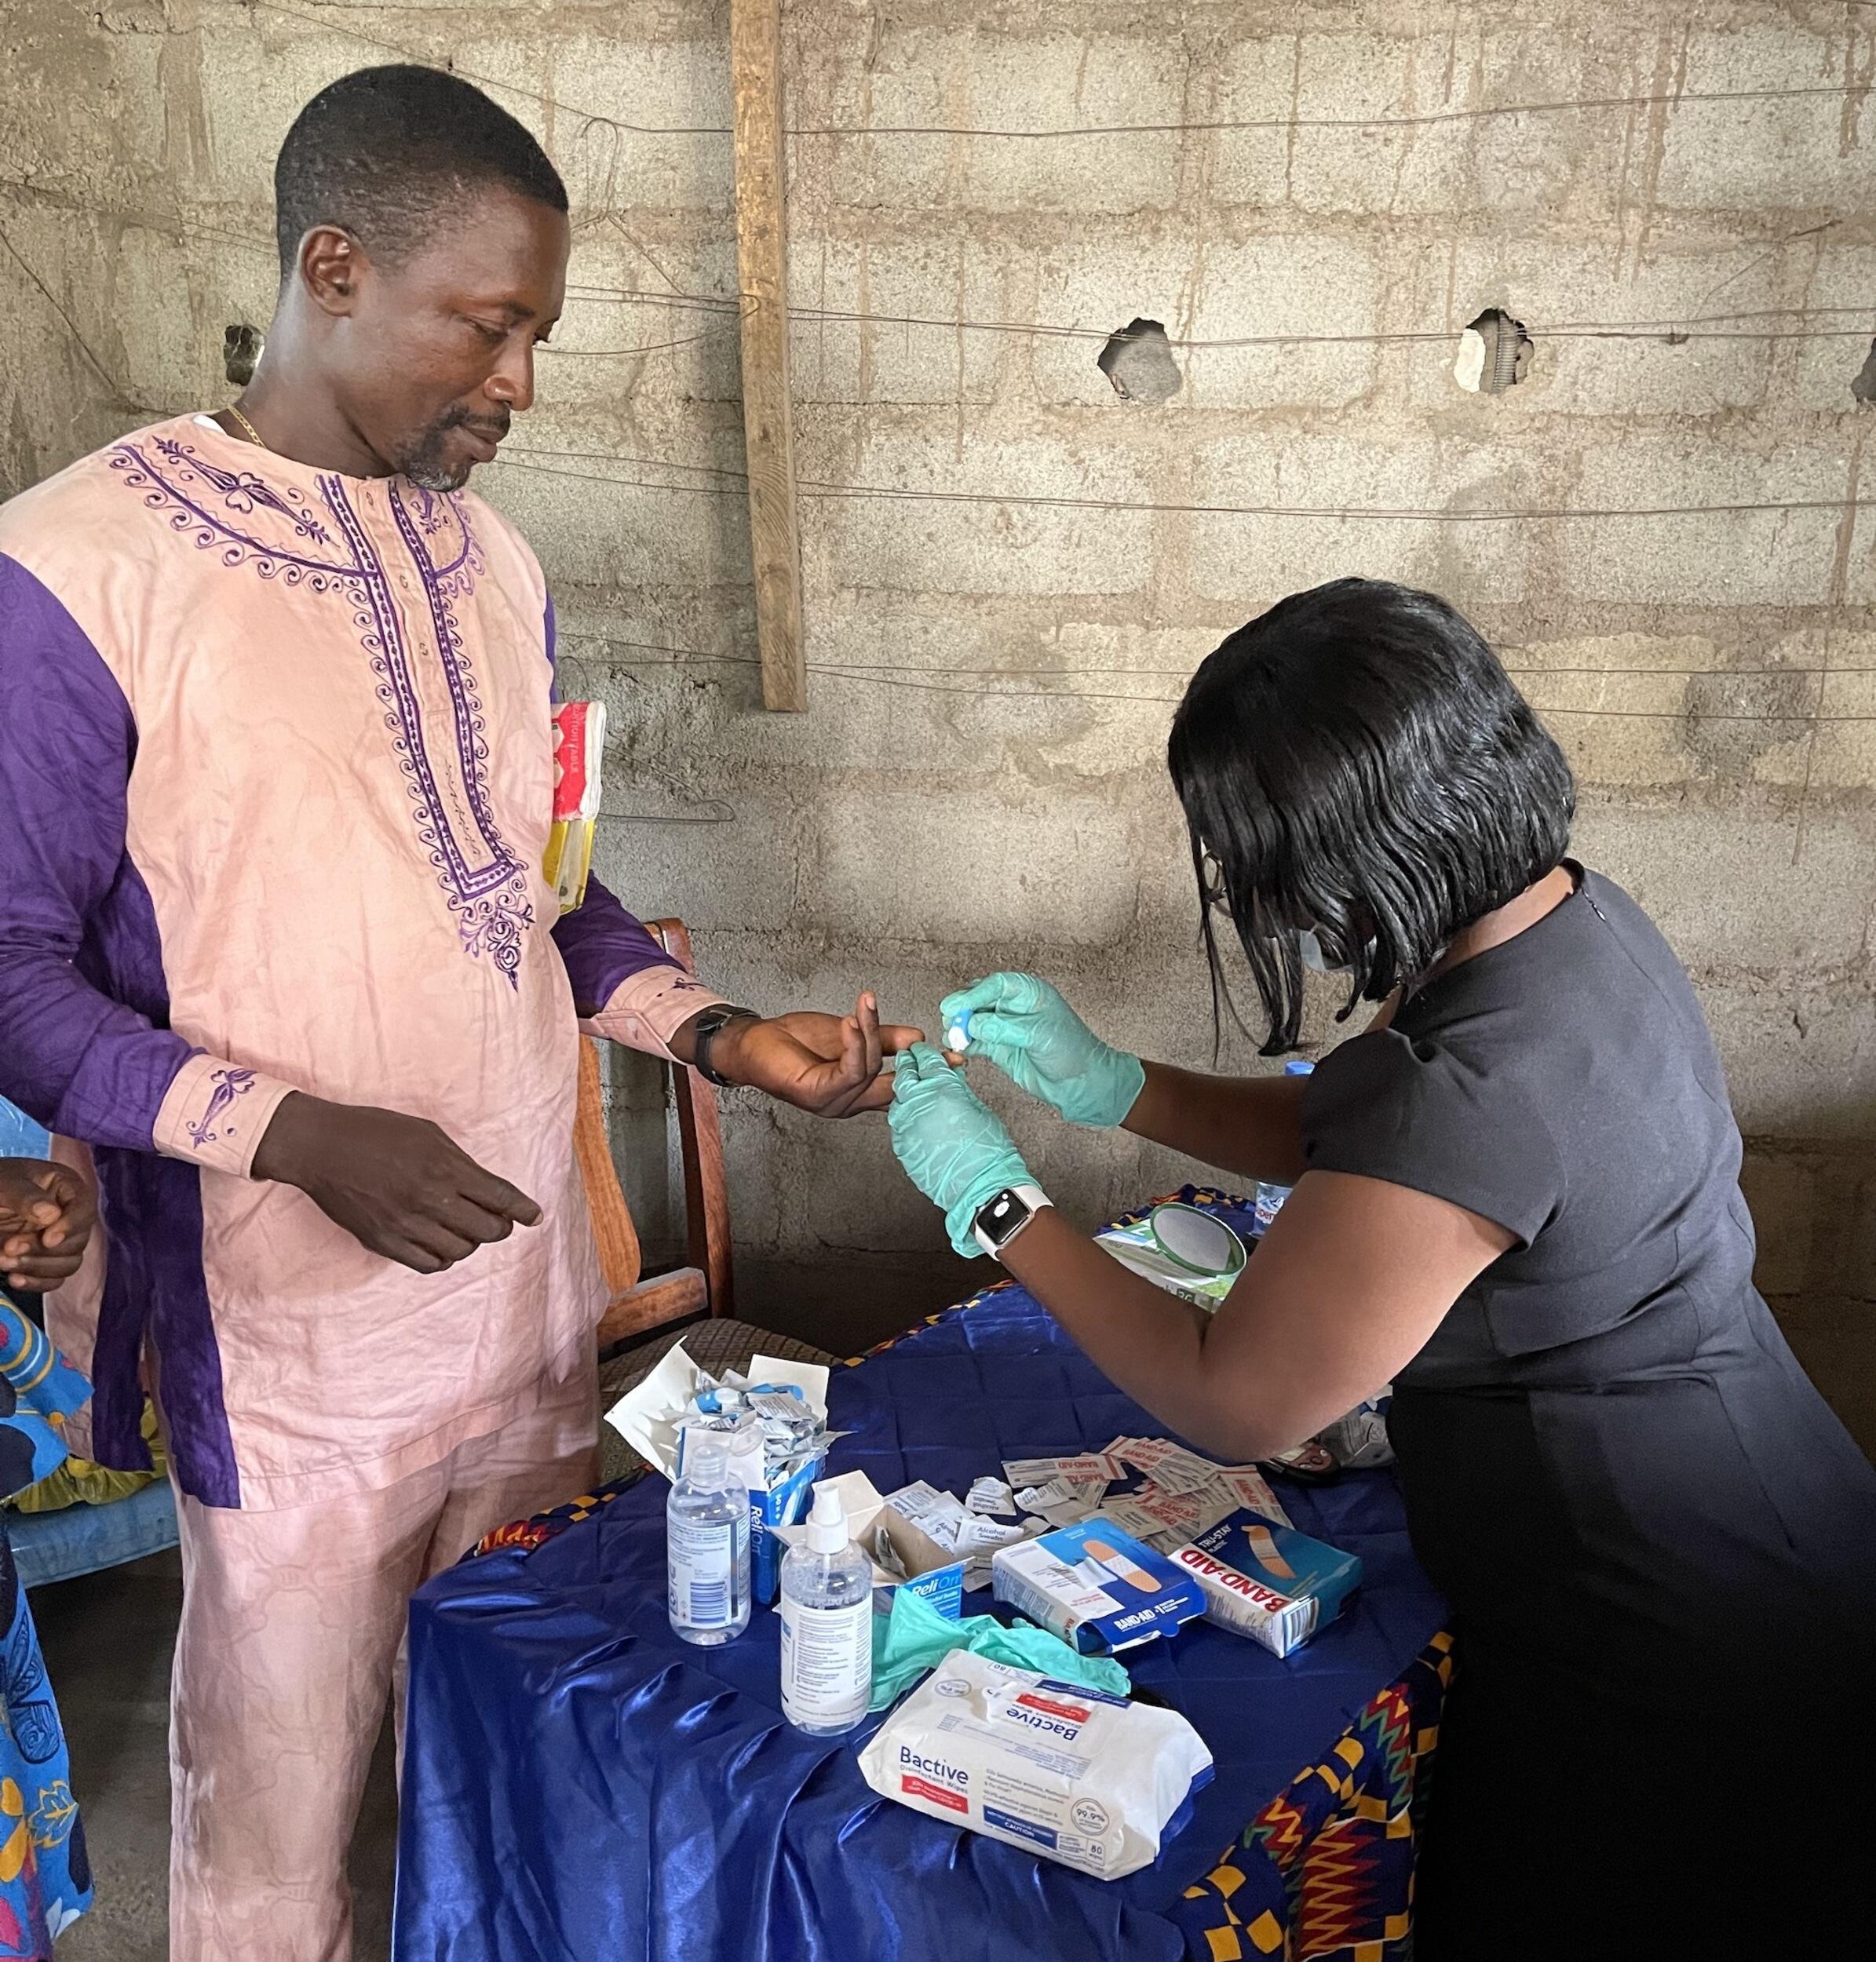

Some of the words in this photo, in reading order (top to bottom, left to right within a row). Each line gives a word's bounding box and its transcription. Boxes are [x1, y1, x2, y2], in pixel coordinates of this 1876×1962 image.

[751, 1505, 764, 1555] ReliOn
[977, 1527, 1006, 1536] Alcohol
[1199, 1523, 1232, 1548] TRU-STAY
[912, 1574, 960, 1597] ReliOn
[1181, 1549, 1290, 1612] BAND-AID
[1114, 1608, 1156, 1629] BAND-AID
[1006, 1709, 1079, 1741] Bactive
[900, 1745, 969, 1785] Bactive
[947, 1779, 969, 1794] Wipes
[1005, 1822, 1035, 1837] CAUTION
[1090, 1844, 1103, 1855] 80
